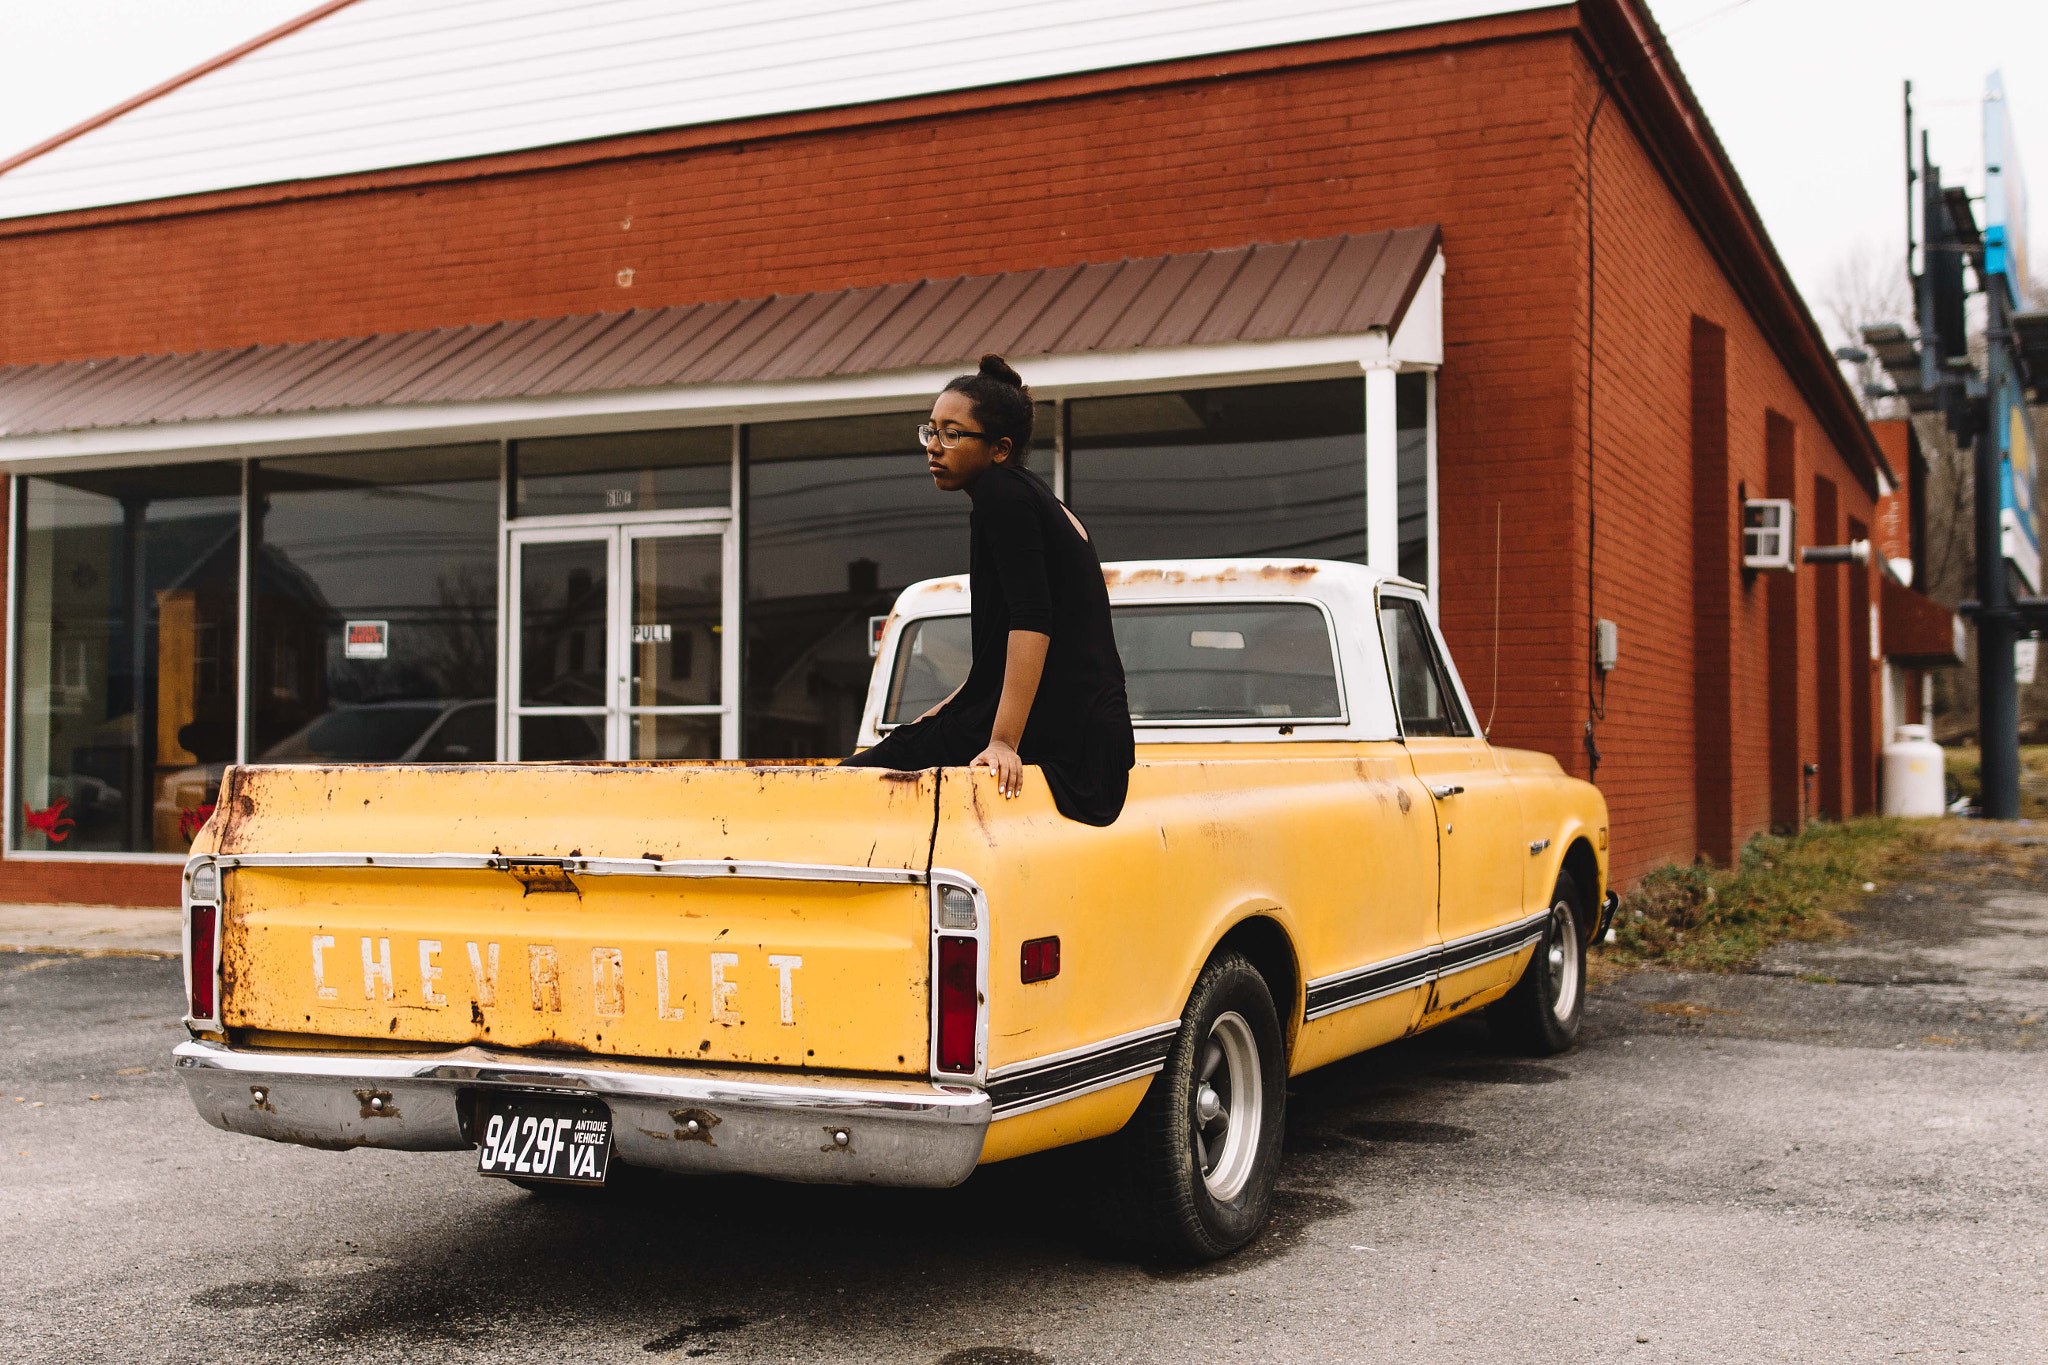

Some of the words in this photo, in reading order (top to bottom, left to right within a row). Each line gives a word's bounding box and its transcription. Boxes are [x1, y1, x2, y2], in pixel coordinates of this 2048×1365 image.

[633, 625, 670, 641] PULL
[312, 935, 802, 1027] CHEVROLET
[575, 1119, 608, 1132] ANTIQUE
[481, 1114, 573, 1175] 9429F
[574, 1132, 605, 1145] VEHICLE
[569, 1144, 602, 1178] VA.
